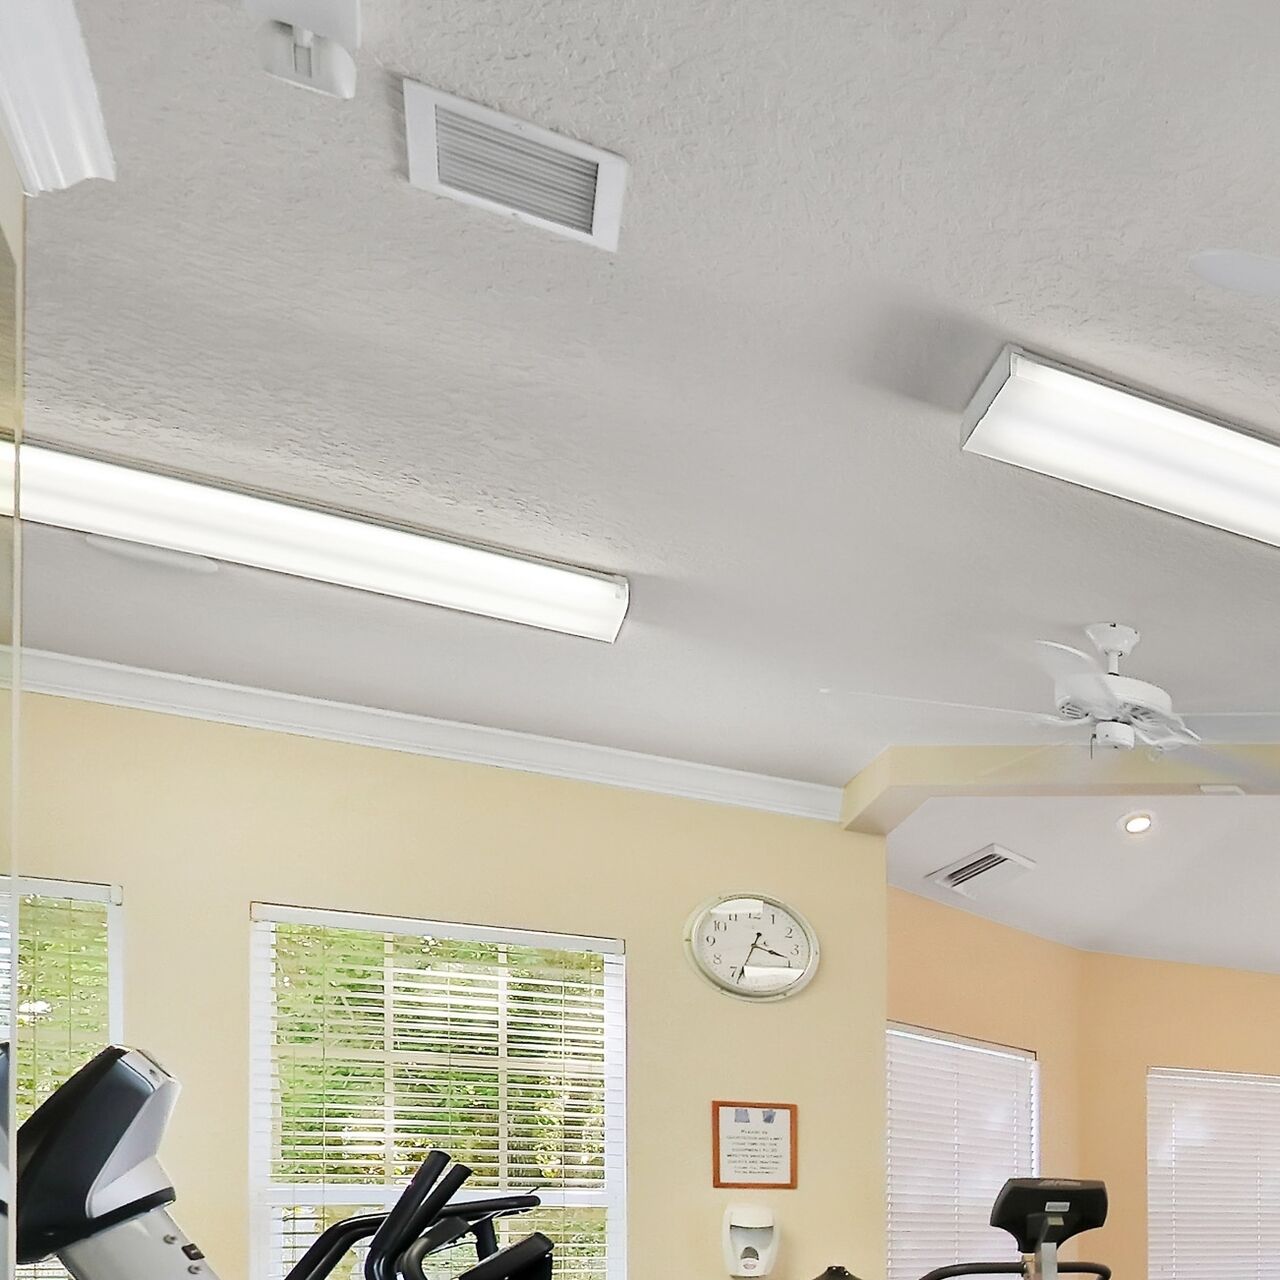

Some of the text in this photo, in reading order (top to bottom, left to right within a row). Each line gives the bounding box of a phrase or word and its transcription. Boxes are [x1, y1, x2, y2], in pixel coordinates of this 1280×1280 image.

[770, 914, 775, 925] 1
[713, 920, 727, 932] 10
[785, 926, 793, 939] 2
[706, 935, 716, 947] 9
[790, 944, 800, 956] 3
[713, 953, 722, 965] 8
[729, 966, 738, 978] 7
